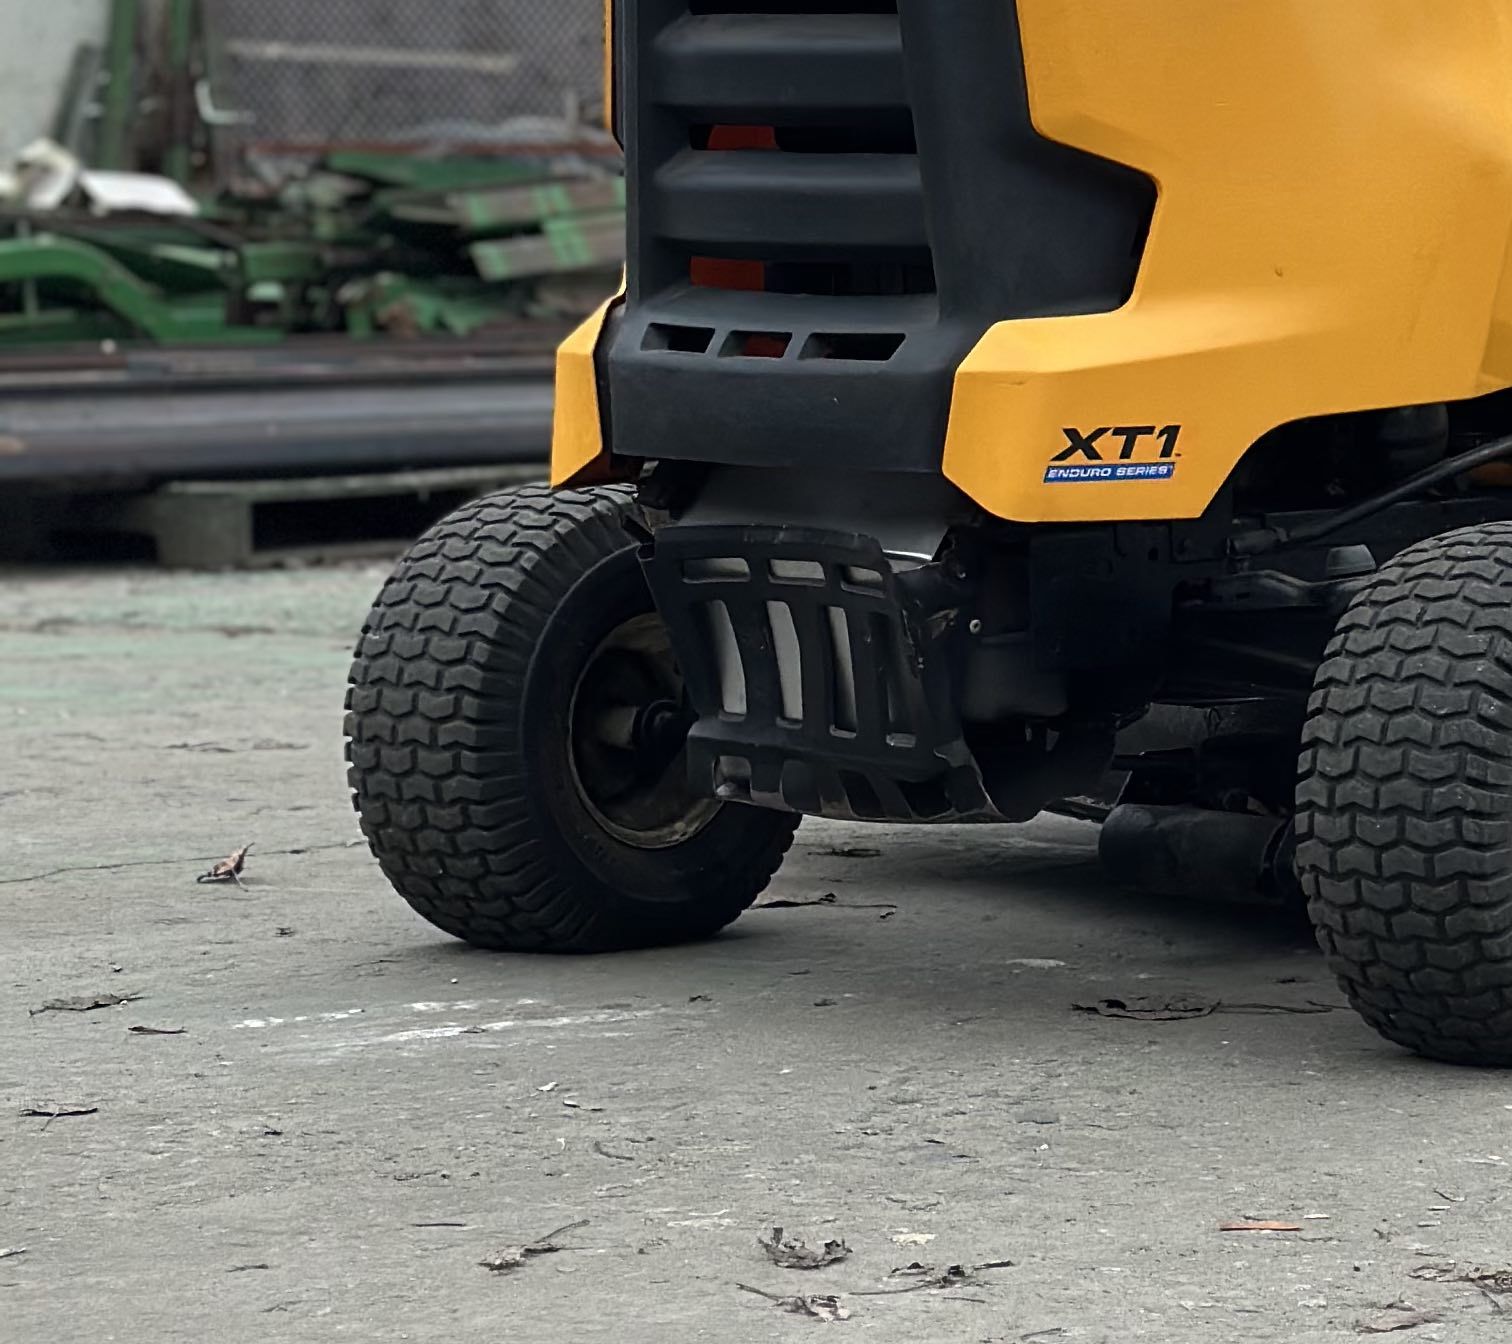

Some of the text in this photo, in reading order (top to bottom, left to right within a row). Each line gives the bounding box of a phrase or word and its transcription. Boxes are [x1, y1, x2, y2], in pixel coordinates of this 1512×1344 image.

[1050, 425, 1182, 462] XT1
[1048, 465, 1168, 478] ENDURO SERIES
